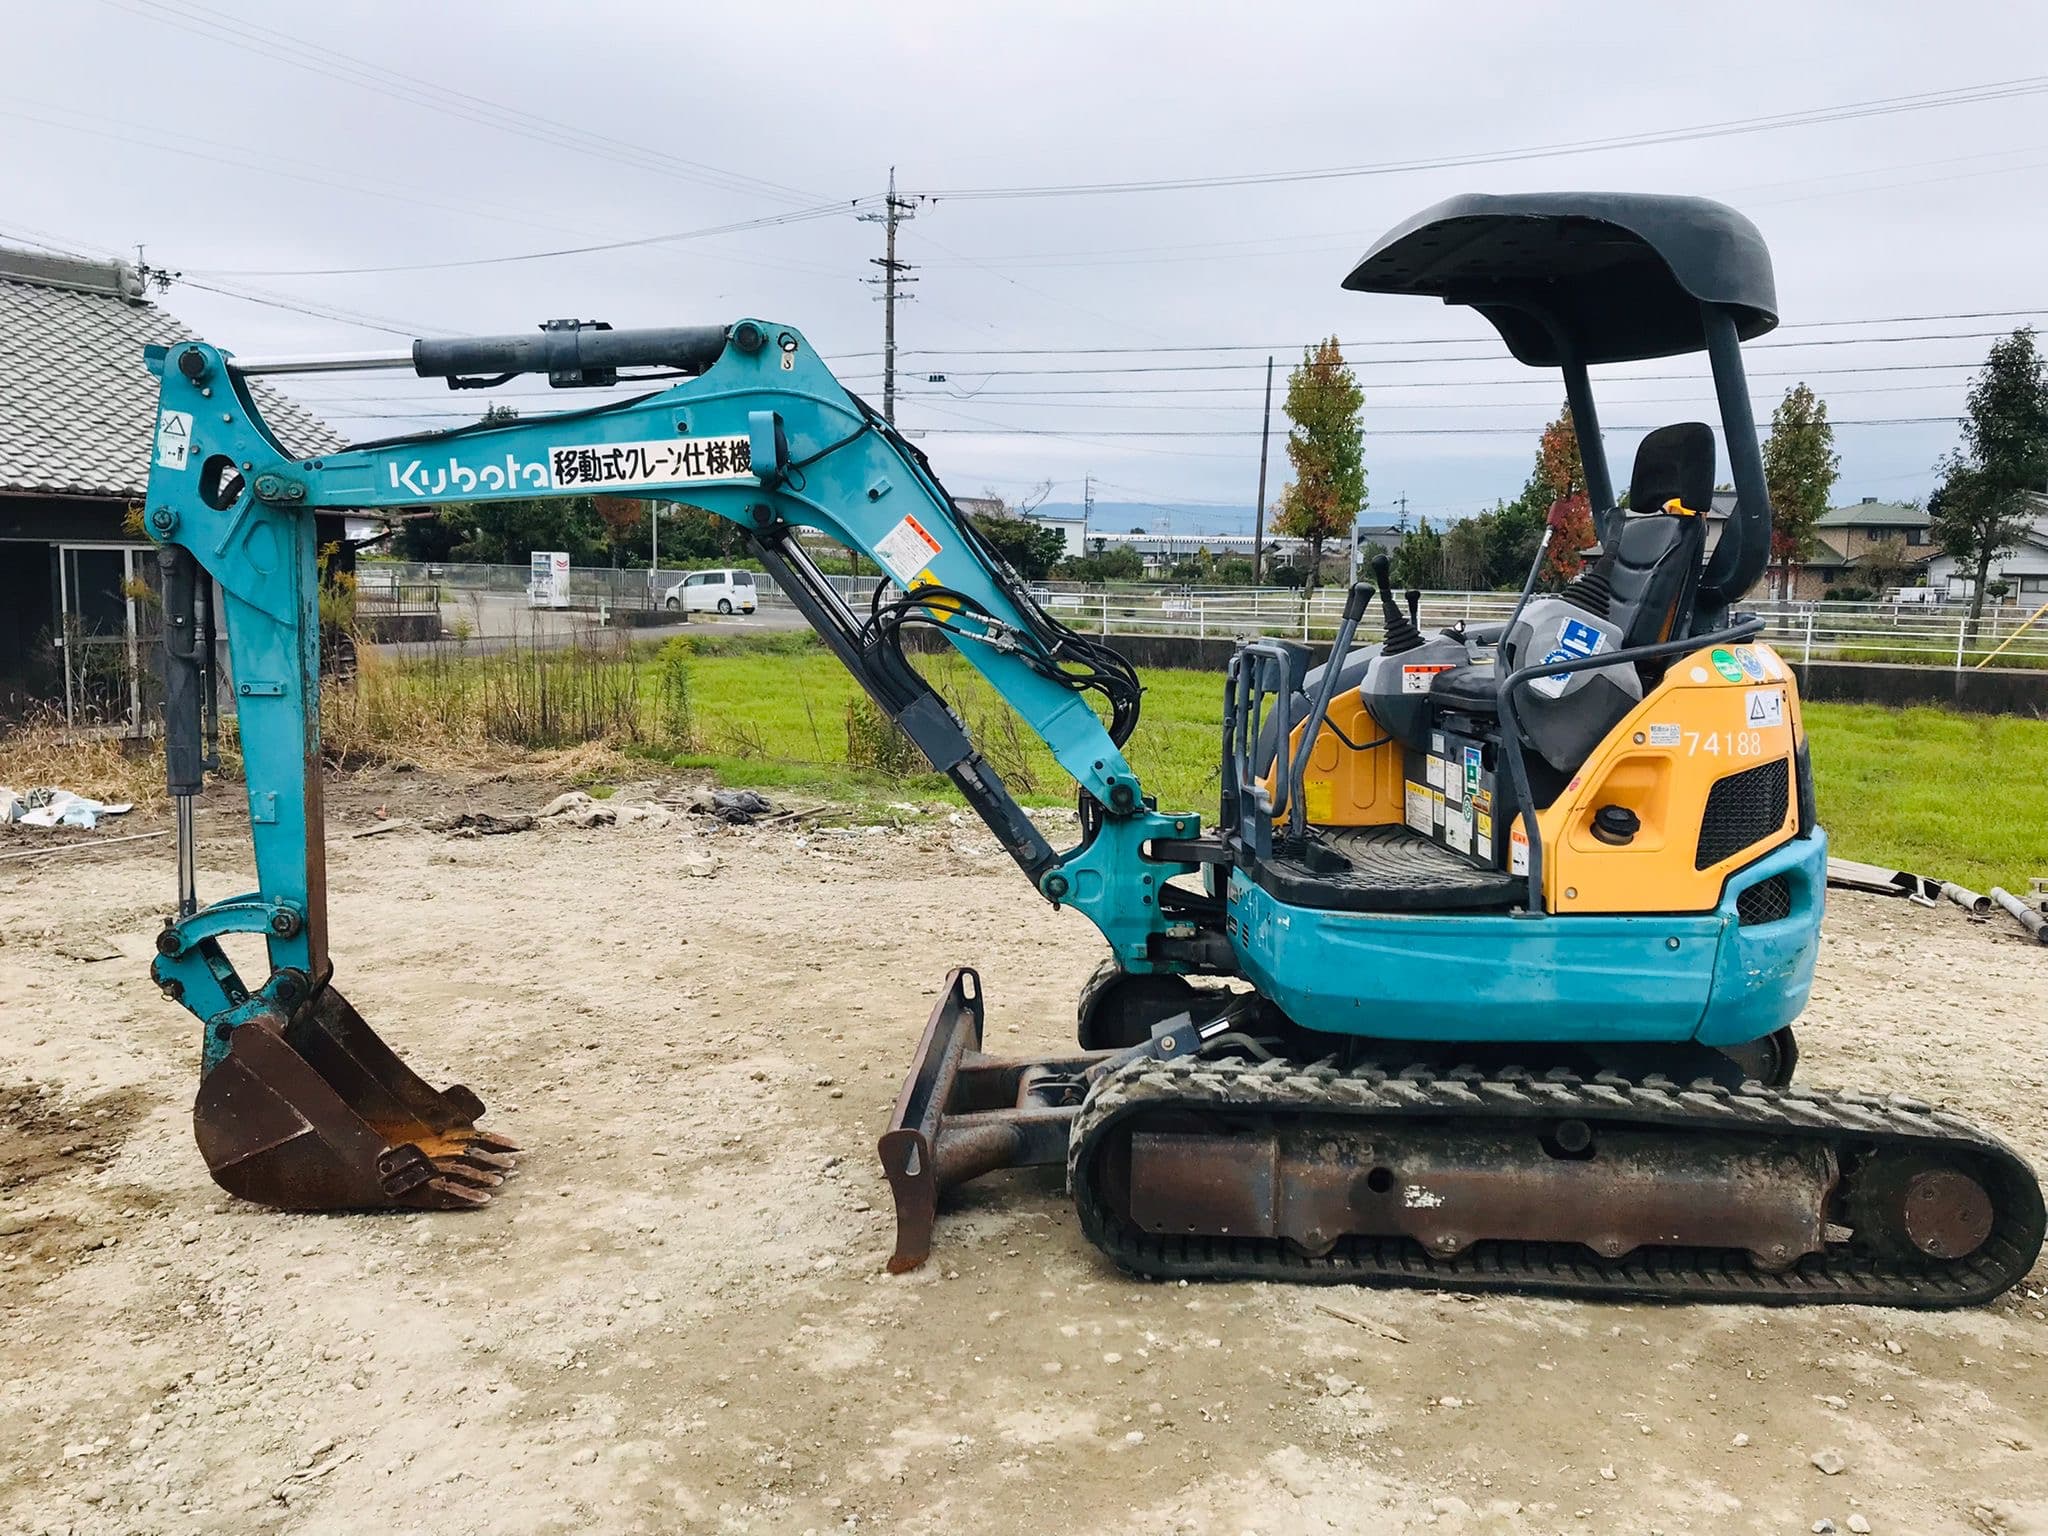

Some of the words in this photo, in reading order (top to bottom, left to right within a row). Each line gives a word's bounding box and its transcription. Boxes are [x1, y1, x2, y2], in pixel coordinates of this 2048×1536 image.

[389, 454, 549, 496] Kubota
[554, 439, 752, 486] 移動式クレーン仕様機
[1684, 732, 1761, 756] 74188
